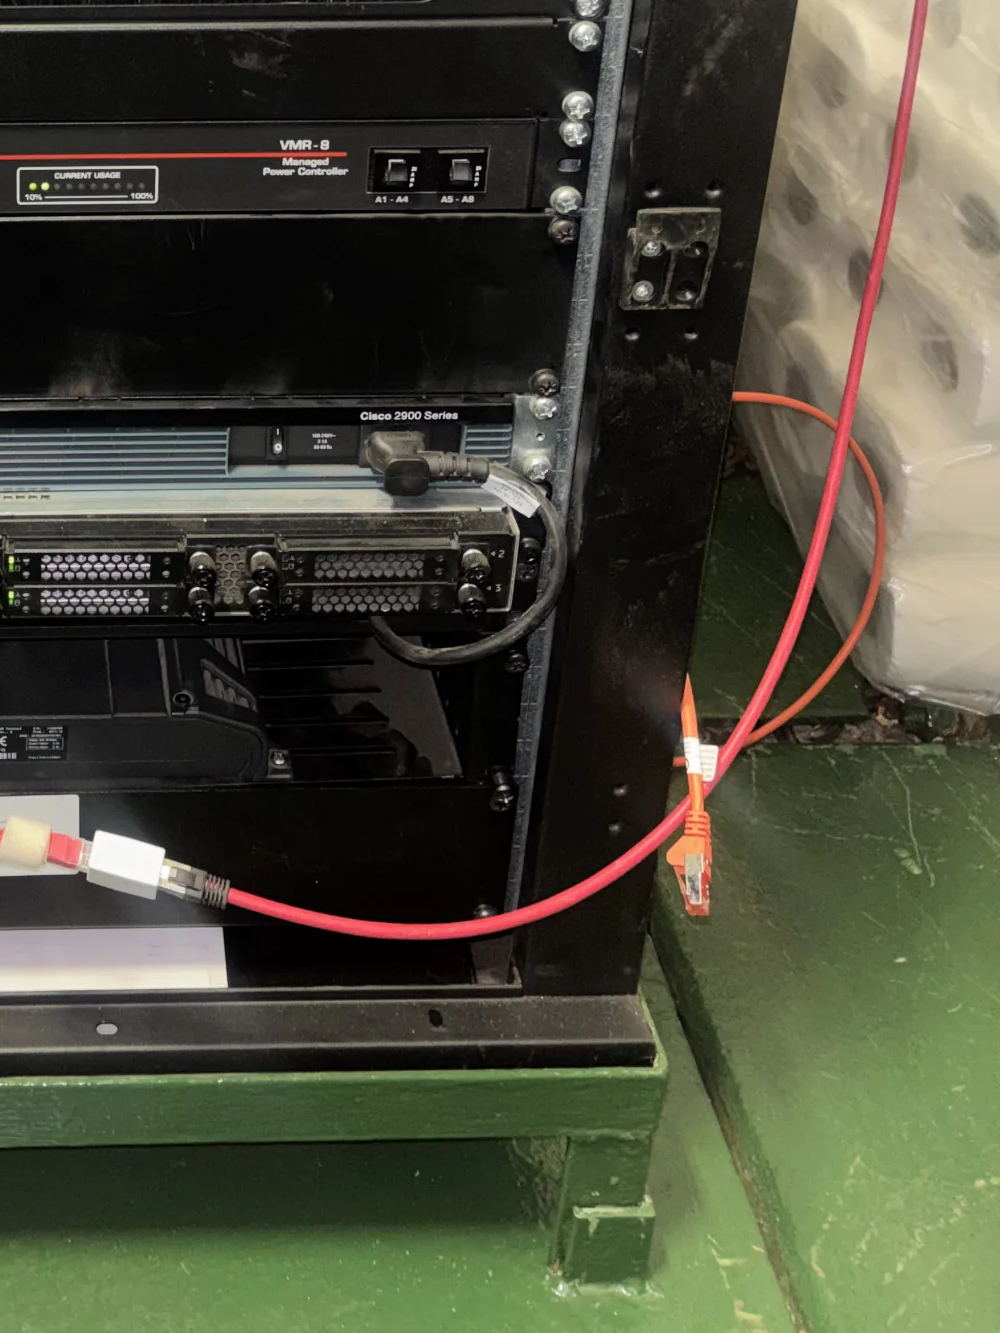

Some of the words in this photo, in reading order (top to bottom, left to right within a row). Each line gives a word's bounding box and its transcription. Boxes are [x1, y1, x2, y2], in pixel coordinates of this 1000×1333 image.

[281, 157, 330, 168] Managed
[53, 172, 92, 180] CURRENT
[93, 171, 121, 179] USAGE
[262, 167, 296, 176] Power
[297, 167, 349, 176] Controller
[24, 193, 43, 201] 10%
[130, 192, 153, 200] 100%
[374, 195, 389, 204] A1
[395, 195, 409, 203] A4
[440, 195, 454, 204] A5
[461, 195, 475, 203] A8
[360, 411, 392, 422] Cisco
[393, 411, 422, 421] 2900
[424, 410, 459, 420] Series
[498, 549, 505, 558] 2
[495, 584, 501, 592] 3
